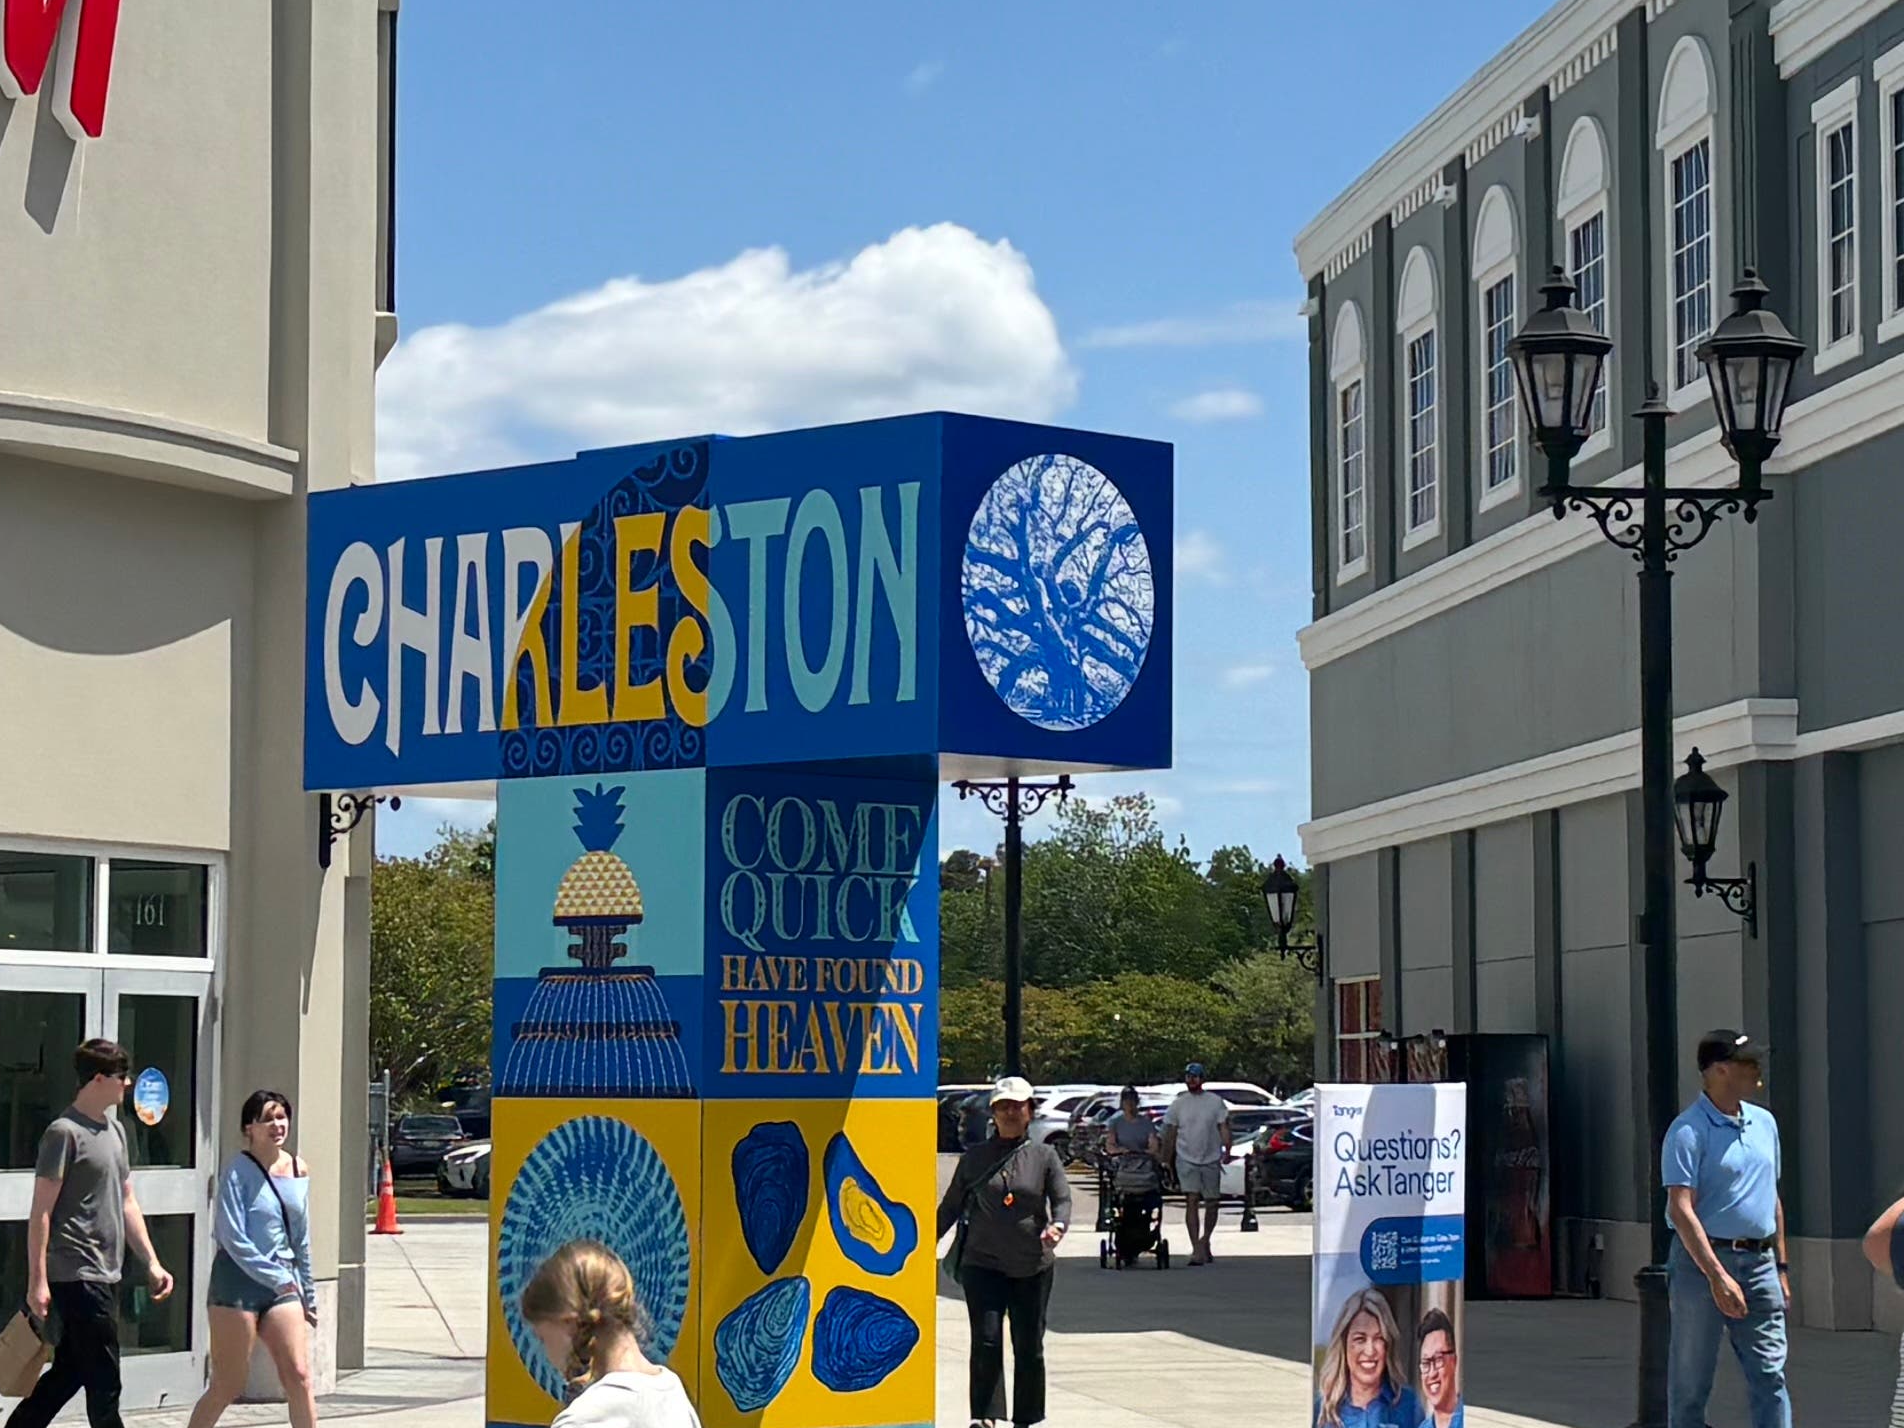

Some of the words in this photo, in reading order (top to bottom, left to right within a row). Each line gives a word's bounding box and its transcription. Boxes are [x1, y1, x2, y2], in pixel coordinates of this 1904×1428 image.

[324, 480, 921, 757] CHARLESTON
[721, 793, 921, 876] COME
[136, 892, 165, 926] 161
[720, 870, 920, 952] QUICK
[720, 955, 807, 991] HAVE
[815, 957, 924, 994] FOUND
[719, 1000, 924, 1075] HEAVEN
[1334, 1128, 1462, 1163] Questions?
[1334, 1164, 1382, 1197] Ask
[1382, 1164, 1456, 1202] Tanger
